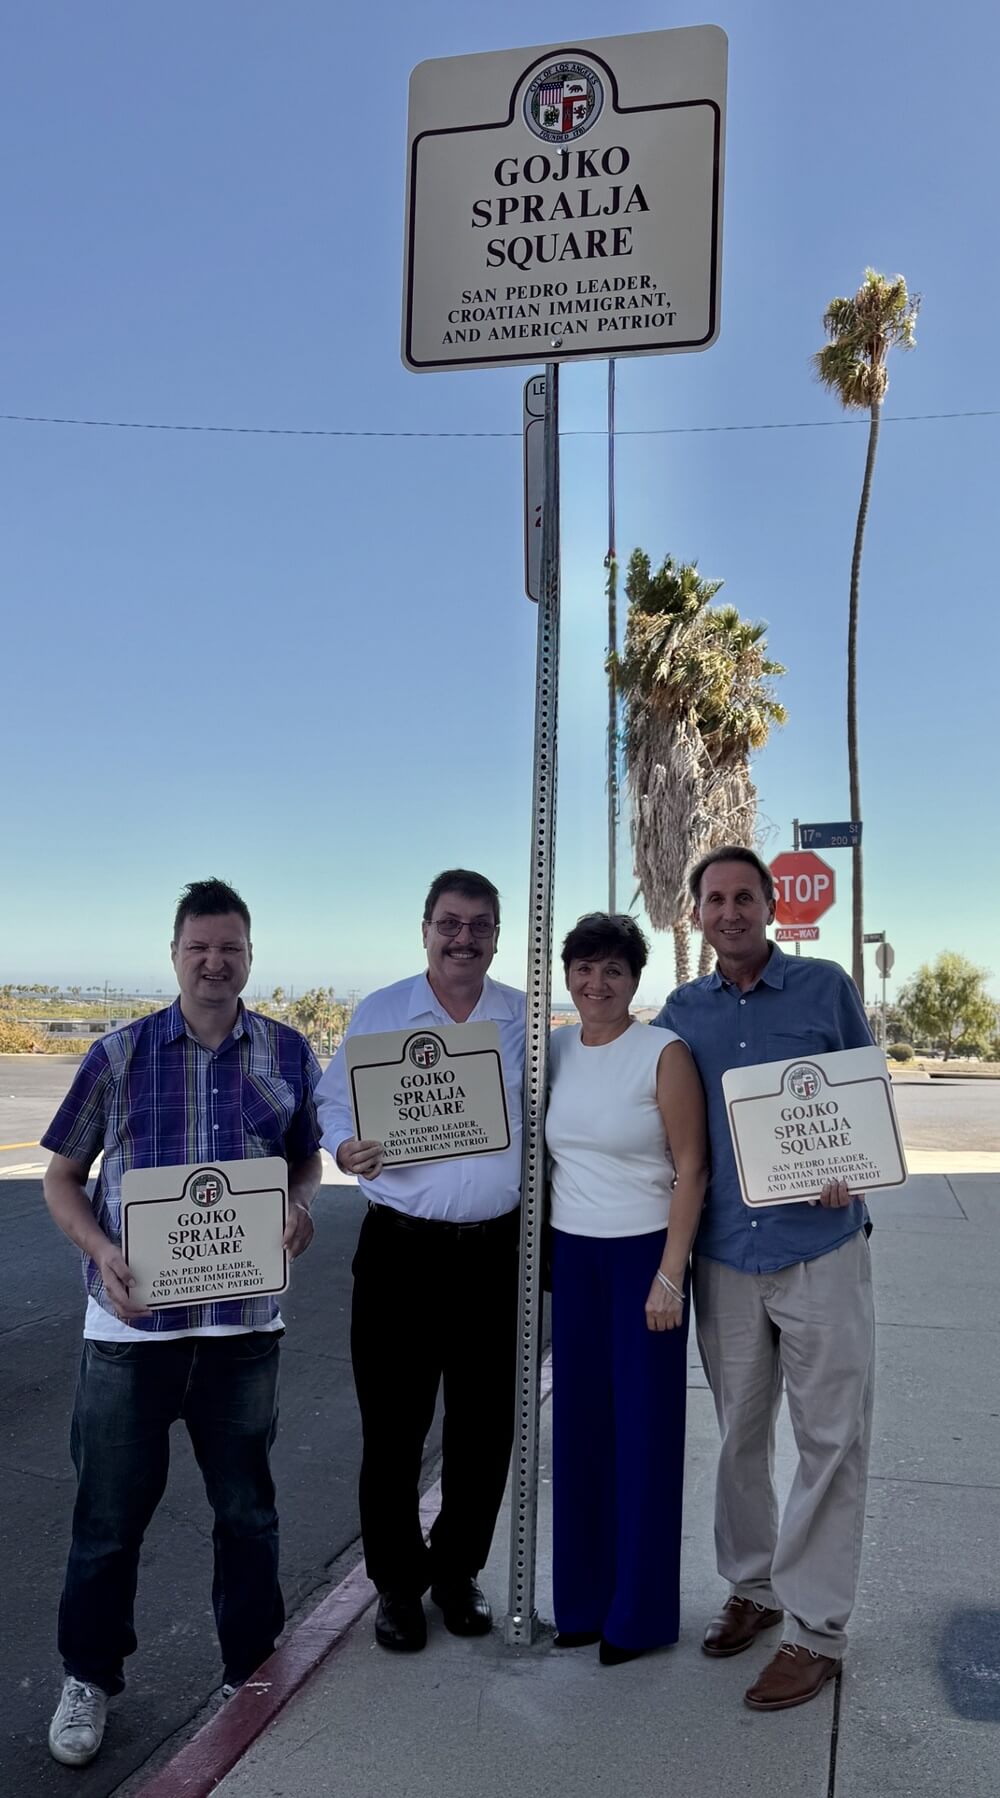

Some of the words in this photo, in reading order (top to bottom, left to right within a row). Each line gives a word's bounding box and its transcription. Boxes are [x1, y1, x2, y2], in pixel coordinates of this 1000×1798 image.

[530, 76, 543, 92] CITY
[544, 70, 552, 78] OF
[571, 64, 598, 85] ANGELES
[540, 130, 569, 140] FOUNDED
[494, 146, 630, 186] GOJKO
[472, 184, 650, 228] SPRALJA
[486, 226, 633, 270] SQUARE
[462, 288, 497, 303] SAN
[506, 282, 568, 301] PEDRO
[576, 274, 657, 294] LEADER,
[448, 303, 540, 324] CROATIAN
[550, 292, 671, 315] IMMIGRANT,
[442, 328, 480, 344] AND
[488, 319, 588, 341] AMERICAN
[597, 312, 677, 331] PATRIOT
[832, 836, 848, 845] 200
[776, 929, 817, 940] ALL-WAY
[401, 1070, 455, 1089] GOJKO
[393, 1086, 466, 1107] SPRALJA
[399, 1100, 465, 1121] SQUARE
[780, 1101, 838, 1122] GOJKO
[384, 1135, 428, 1148] CROATIAN
[431, 1128, 485, 1141] IMMIGRANT,
[389, 1129, 406, 1138] SAN
[410, 1125, 438, 1135] PEDRO
[442, 1120, 478, 1131] LEADER,
[774, 1117, 851, 1140] SPRALJA
[383, 1149, 400, 1158] AND
[405, 1142, 450, 1154] AMERICAN
[454, 1136, 489, 1148] PATRIOT
[781, 1132, 851, 1155] SQUARE
[768, 1169, 813, 1182] CROATIAN
[817, 1161, 877, 1176] IMMIGRANT,
[772, 1163, 790, 1172] SAN
[794, 1159, 824, 1170] PEDRO
[828, 1153, 868, 1165] LEADER,
[768, 1183, 786, 1192] AND
[842, 1170, 881, 1183] PATRIOT
[178, 1209, 236, 1226] GOJKO
[168, 1225, 245, 1245] SPRALJA
[172, 1240, 242, 1260] SQUARE
[152, 1275, 200, 1288] CROATIAN
[204, 1268, 262, 1282] IMMIGRANT,
[160, 1269, 178, 1278] SAN
[182, 1265, 213, 1275] PEDRO
[217, 1261, 255, 1271] LEADER,
[150, 1289, 170, 1298] AND
[174, 1282, 224, 1295] AMERICAN
[228, 1277, 264, 1288] PATRIOT
